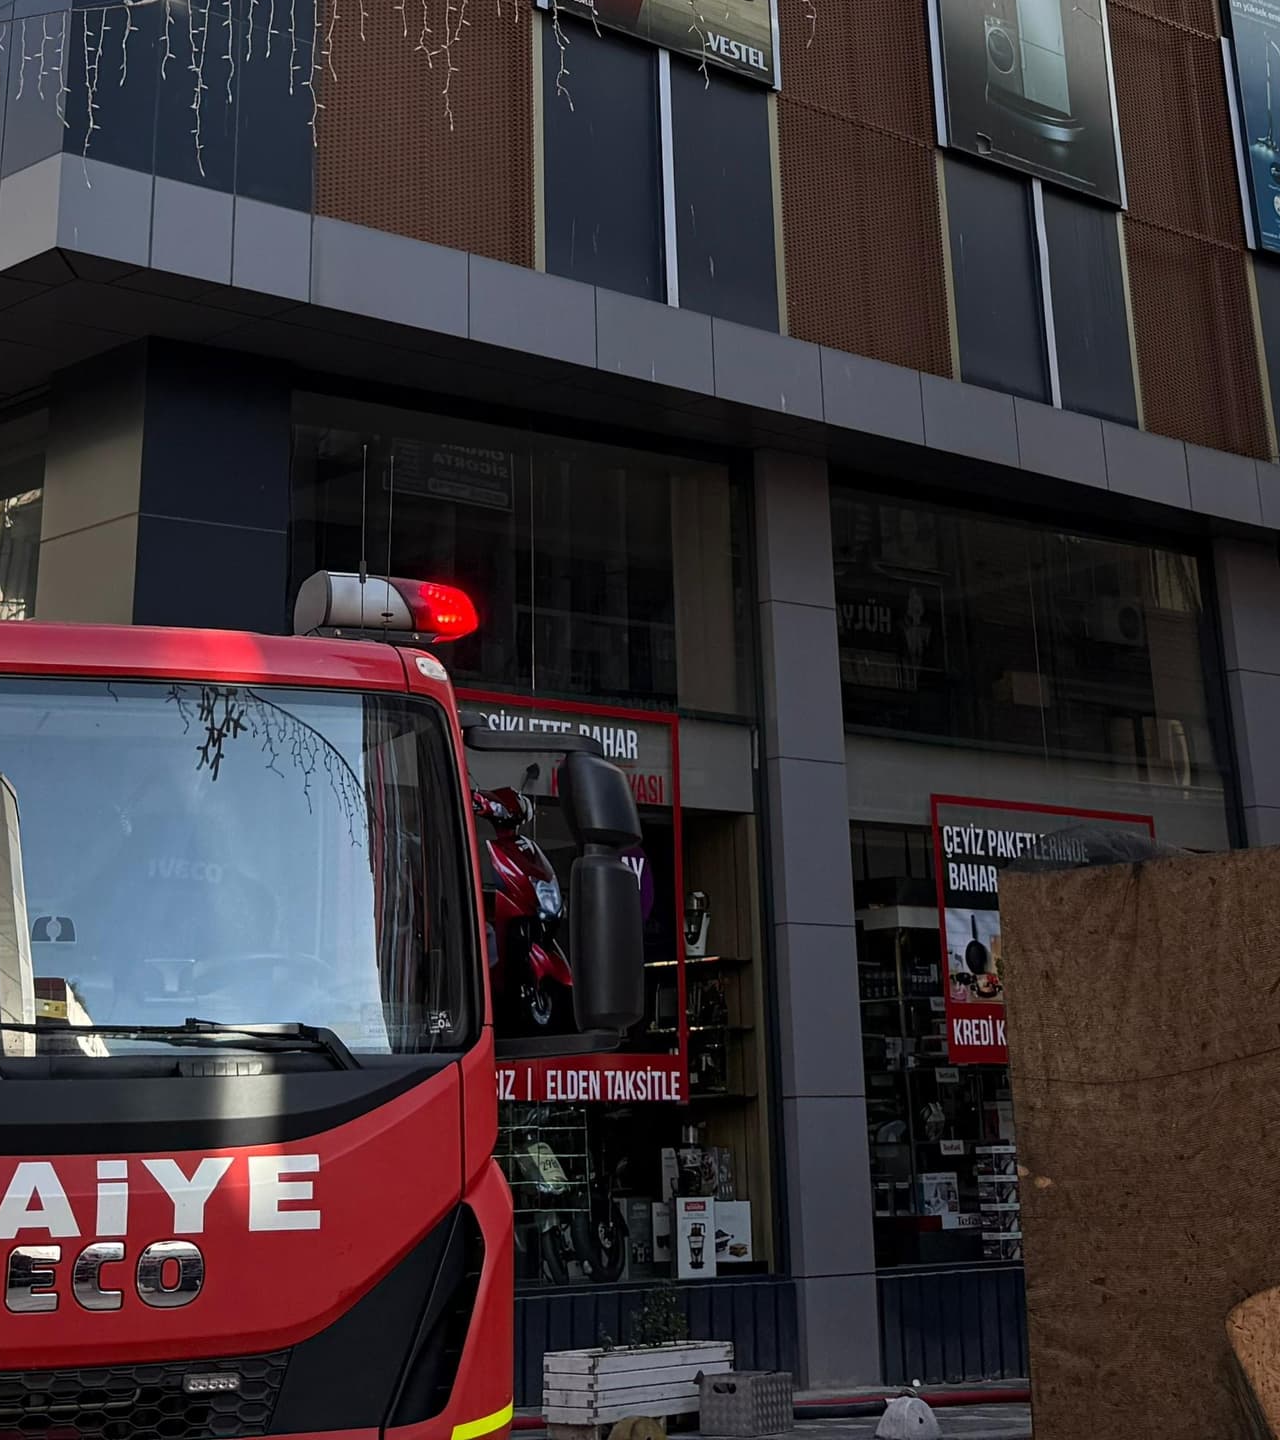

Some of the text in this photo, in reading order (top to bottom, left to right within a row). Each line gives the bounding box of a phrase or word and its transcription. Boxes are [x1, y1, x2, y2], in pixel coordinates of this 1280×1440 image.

[707, 31, 769, 72] VESTEL
[942, 822, 987, 858] ÇEYİZ
[948, 861, 998, 893] BAHAR
[952, 1015, 996, 1046] KREDİ
[496, 1066, 681, 1101] IZ ELDEN TAKSİTLE
